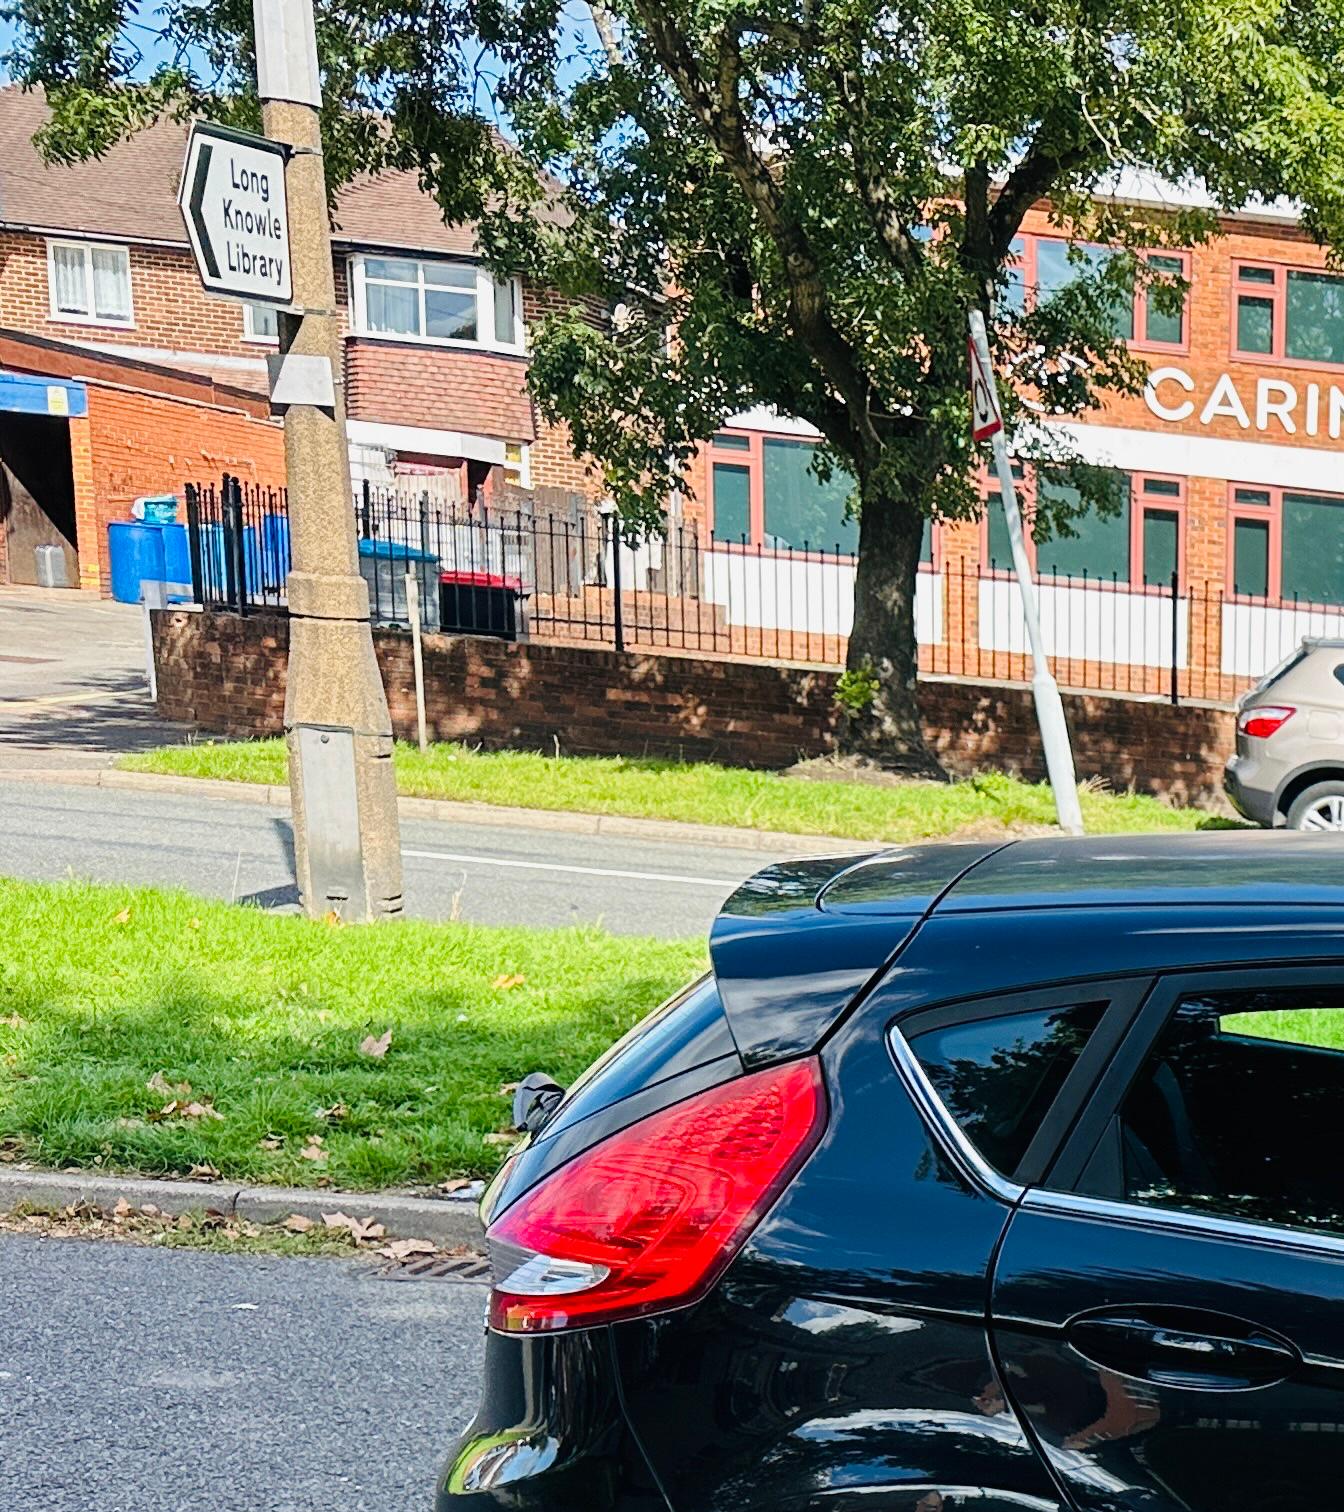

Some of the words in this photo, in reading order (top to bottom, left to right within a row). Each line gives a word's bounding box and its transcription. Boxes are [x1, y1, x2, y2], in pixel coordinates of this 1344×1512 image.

[231, 158, 269, 202] Long
[223, 198, 281, 240] Knowle
[226, 241, 282, 286] Library
